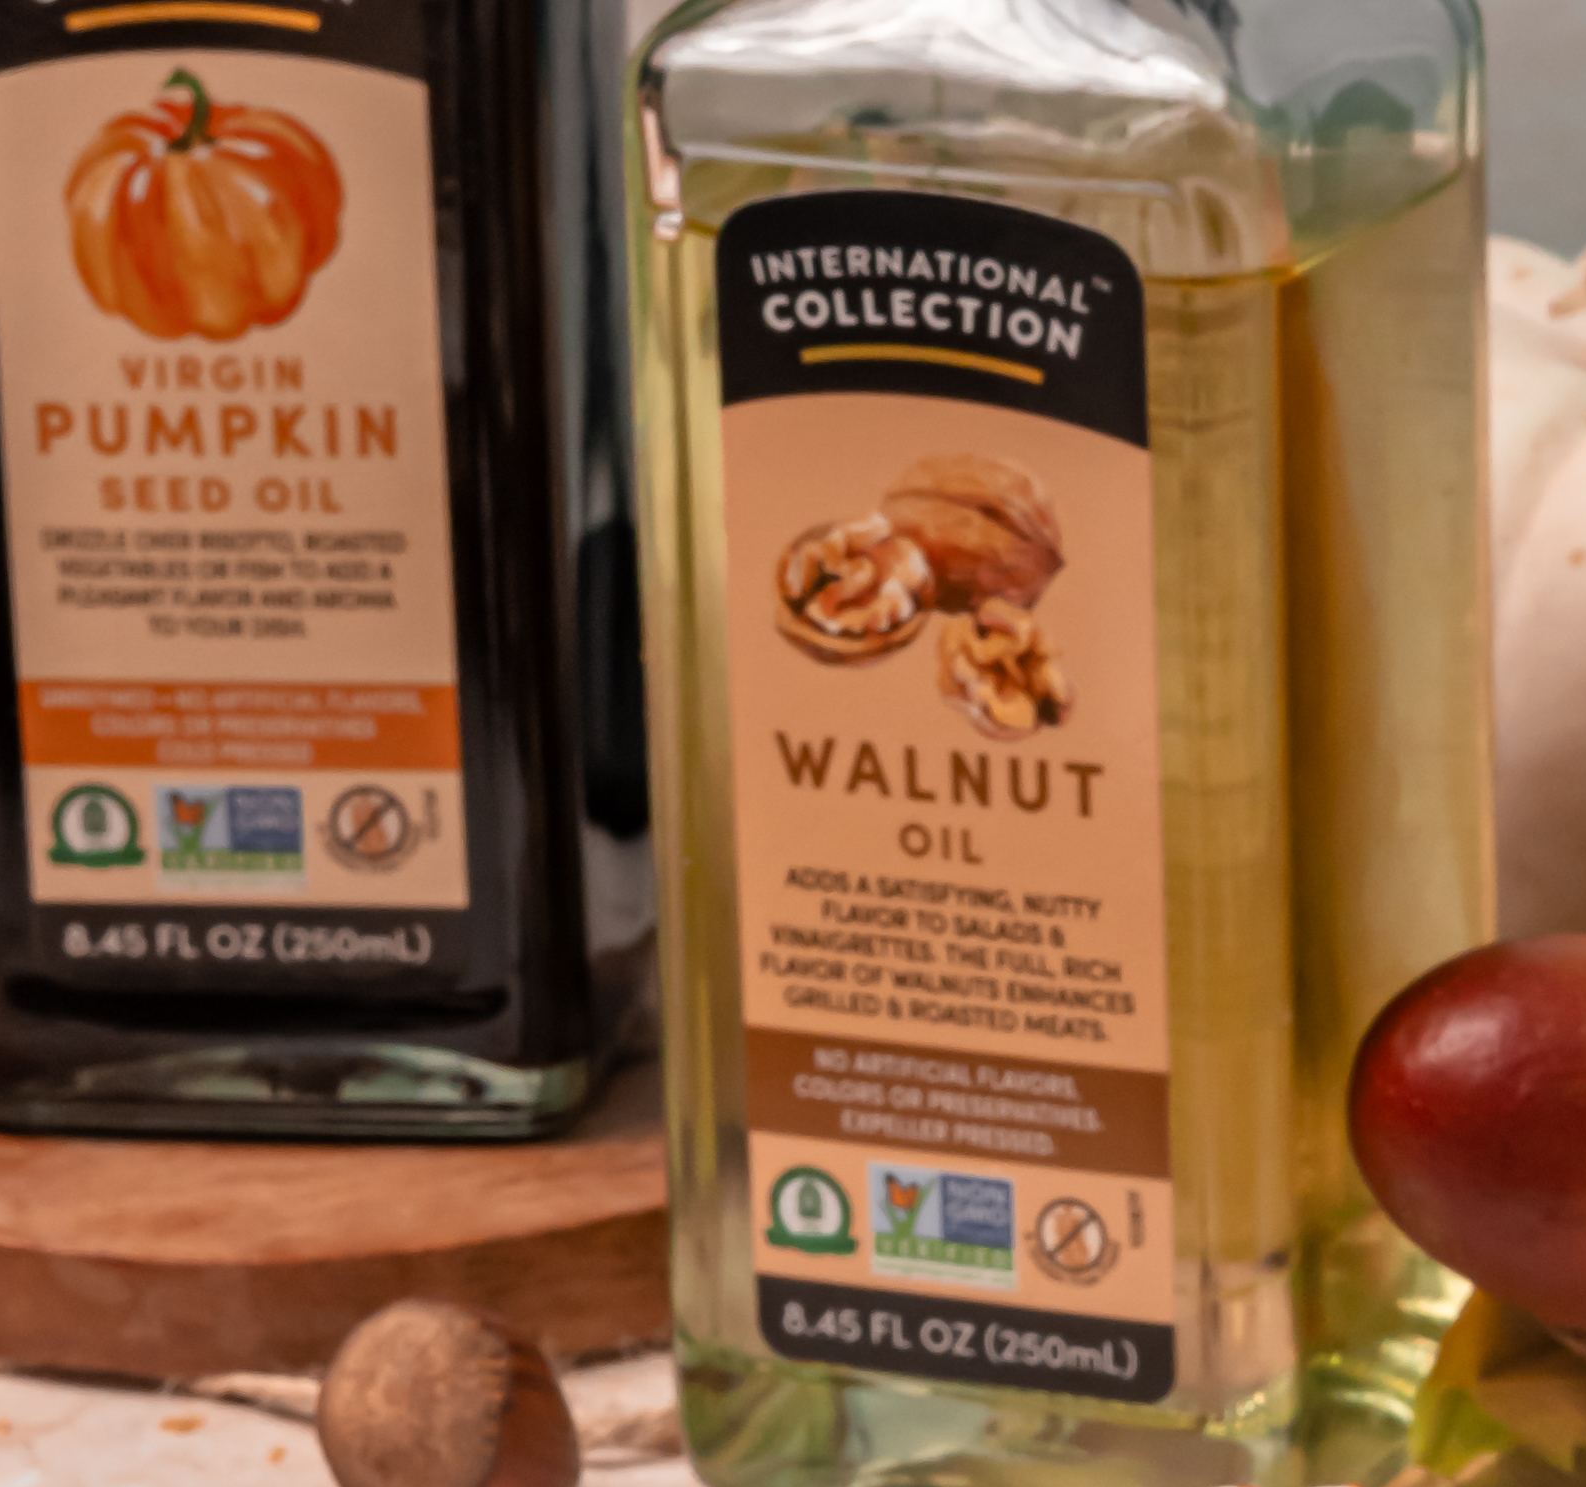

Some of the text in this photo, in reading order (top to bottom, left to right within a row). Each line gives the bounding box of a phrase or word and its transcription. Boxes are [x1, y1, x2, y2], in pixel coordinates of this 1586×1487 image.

[750, 245, 1089, 314] INTERNATIONAL
[763, 288, 1082, 359] COLLECTION
[119, 355, 304, 392] VIRGIN
[35, 401, 397, 459] PUMPKIN
[100, 475, 343, 514] SEED OIL
[774, 730, 1104, 818] WALNUT
[898, 822, 984, 865] OIL
[784, 868, 849, 894] ADDS
[855, 875, 870, 893] A
[1022, 892, 1102, 921] NUTTY
[63, 922, 432, 965] 8.45 FL OZ (250mL)
[821, 899, 908, 928] FLAVOR
[916, 909, 949, 935] TO
[953, 914, 1043, 945] SALADS
[759, 950, 847, 980] FLAVOR
[945, 942, 988, 970] THE
[1065, 955, 1123, 982] RICH
[782, 1301, 1139, 1381] 8.45 FL OZ (250mL)
